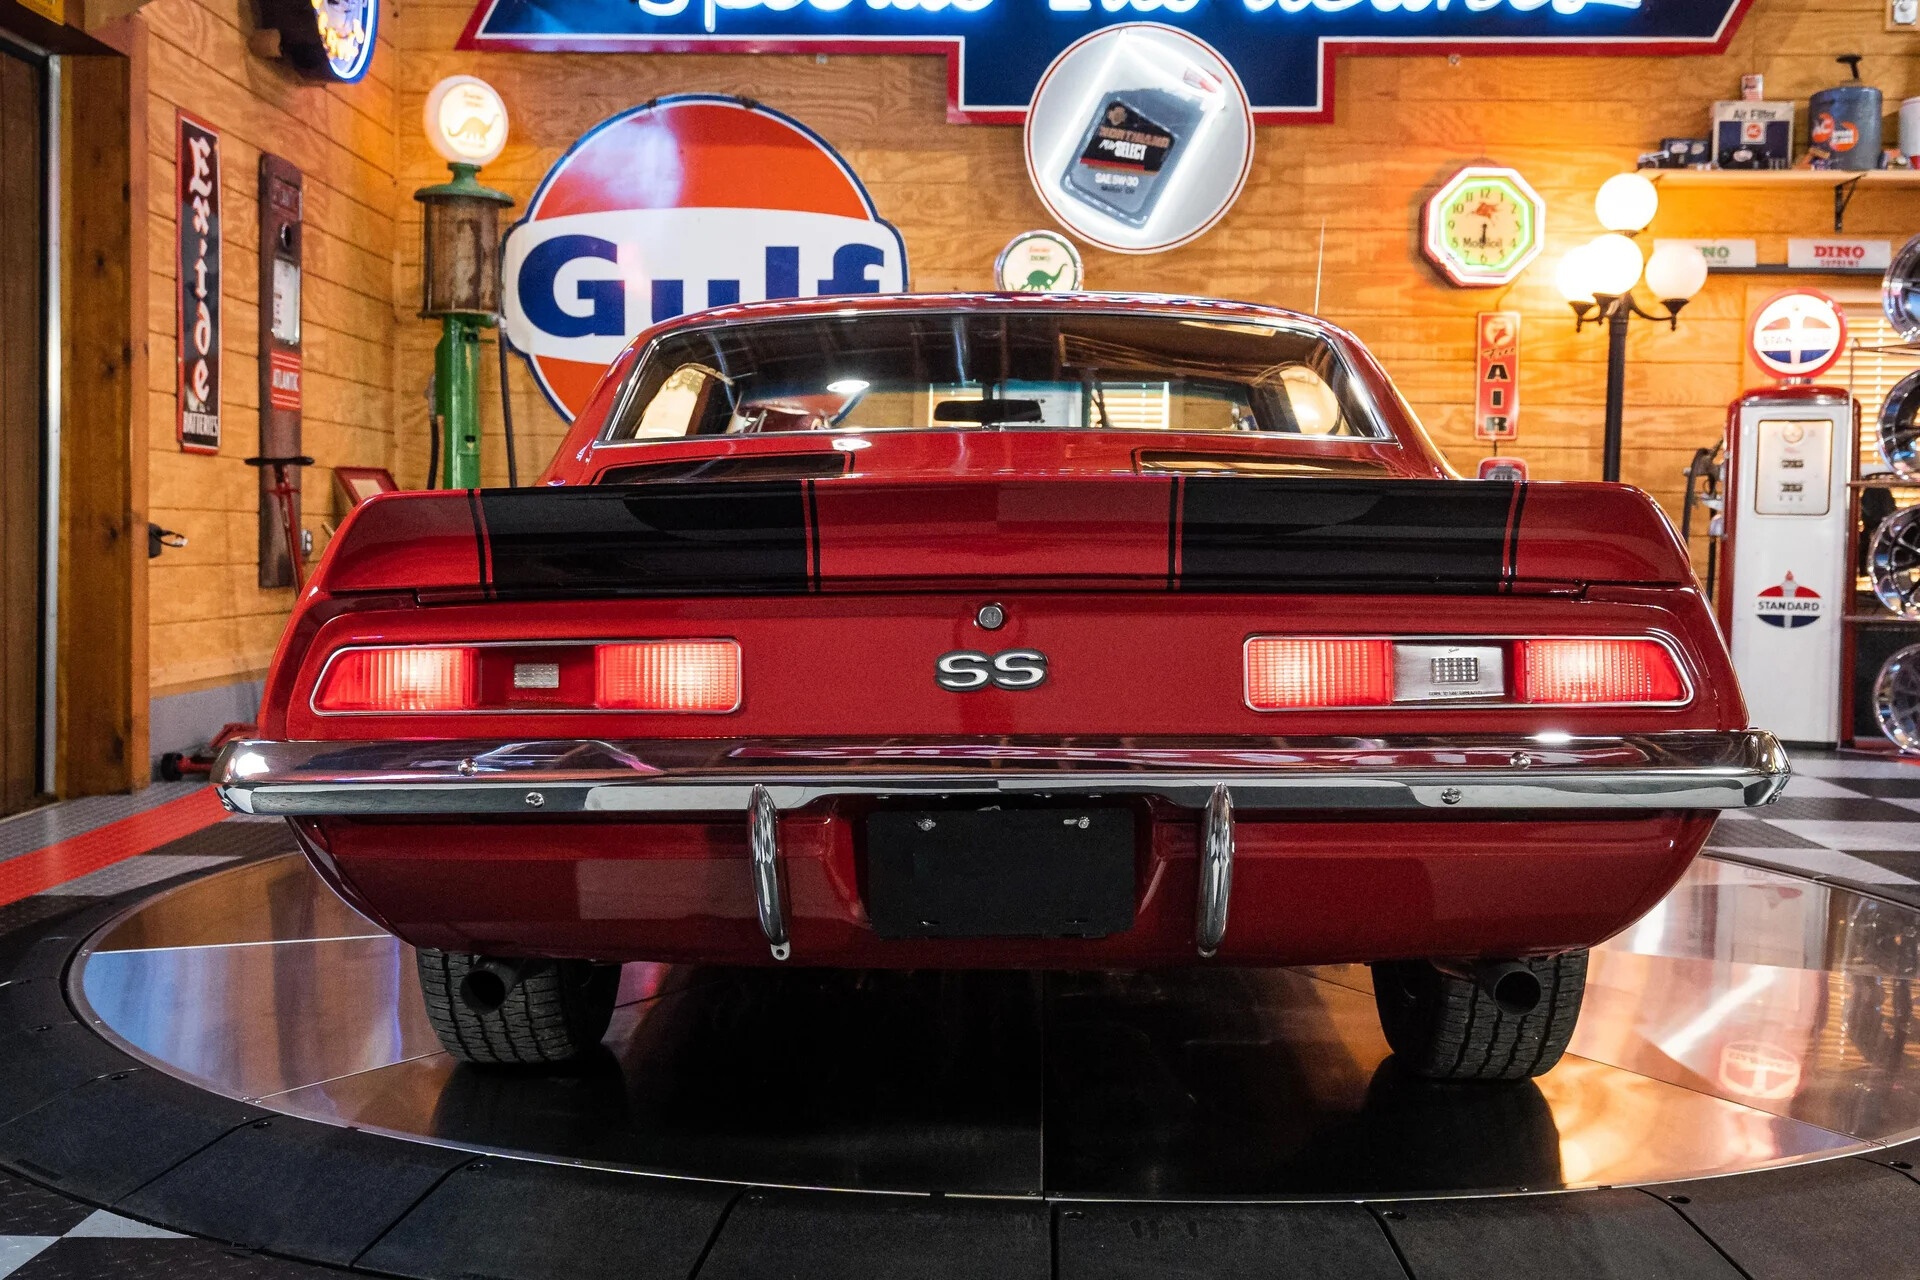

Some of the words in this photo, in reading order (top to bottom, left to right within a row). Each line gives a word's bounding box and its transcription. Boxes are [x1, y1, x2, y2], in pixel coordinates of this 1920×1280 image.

[1480, 188, 1490, 199] 12
[1452, 204, 1464, 213] 10
[1448, 220, 1455, 230] 9
[1696, 246, 1729, 257] NO
[1814, 246, 1865, 258] DINO
[518, 234, 884, 337] Gulf
[1486, 364, 1509, 431] AIR
[183, 411, 218, 437] BATTERIES
[1758, 602, 1820, 611] STANDARD
[936, 649, 1048, 691] SS
